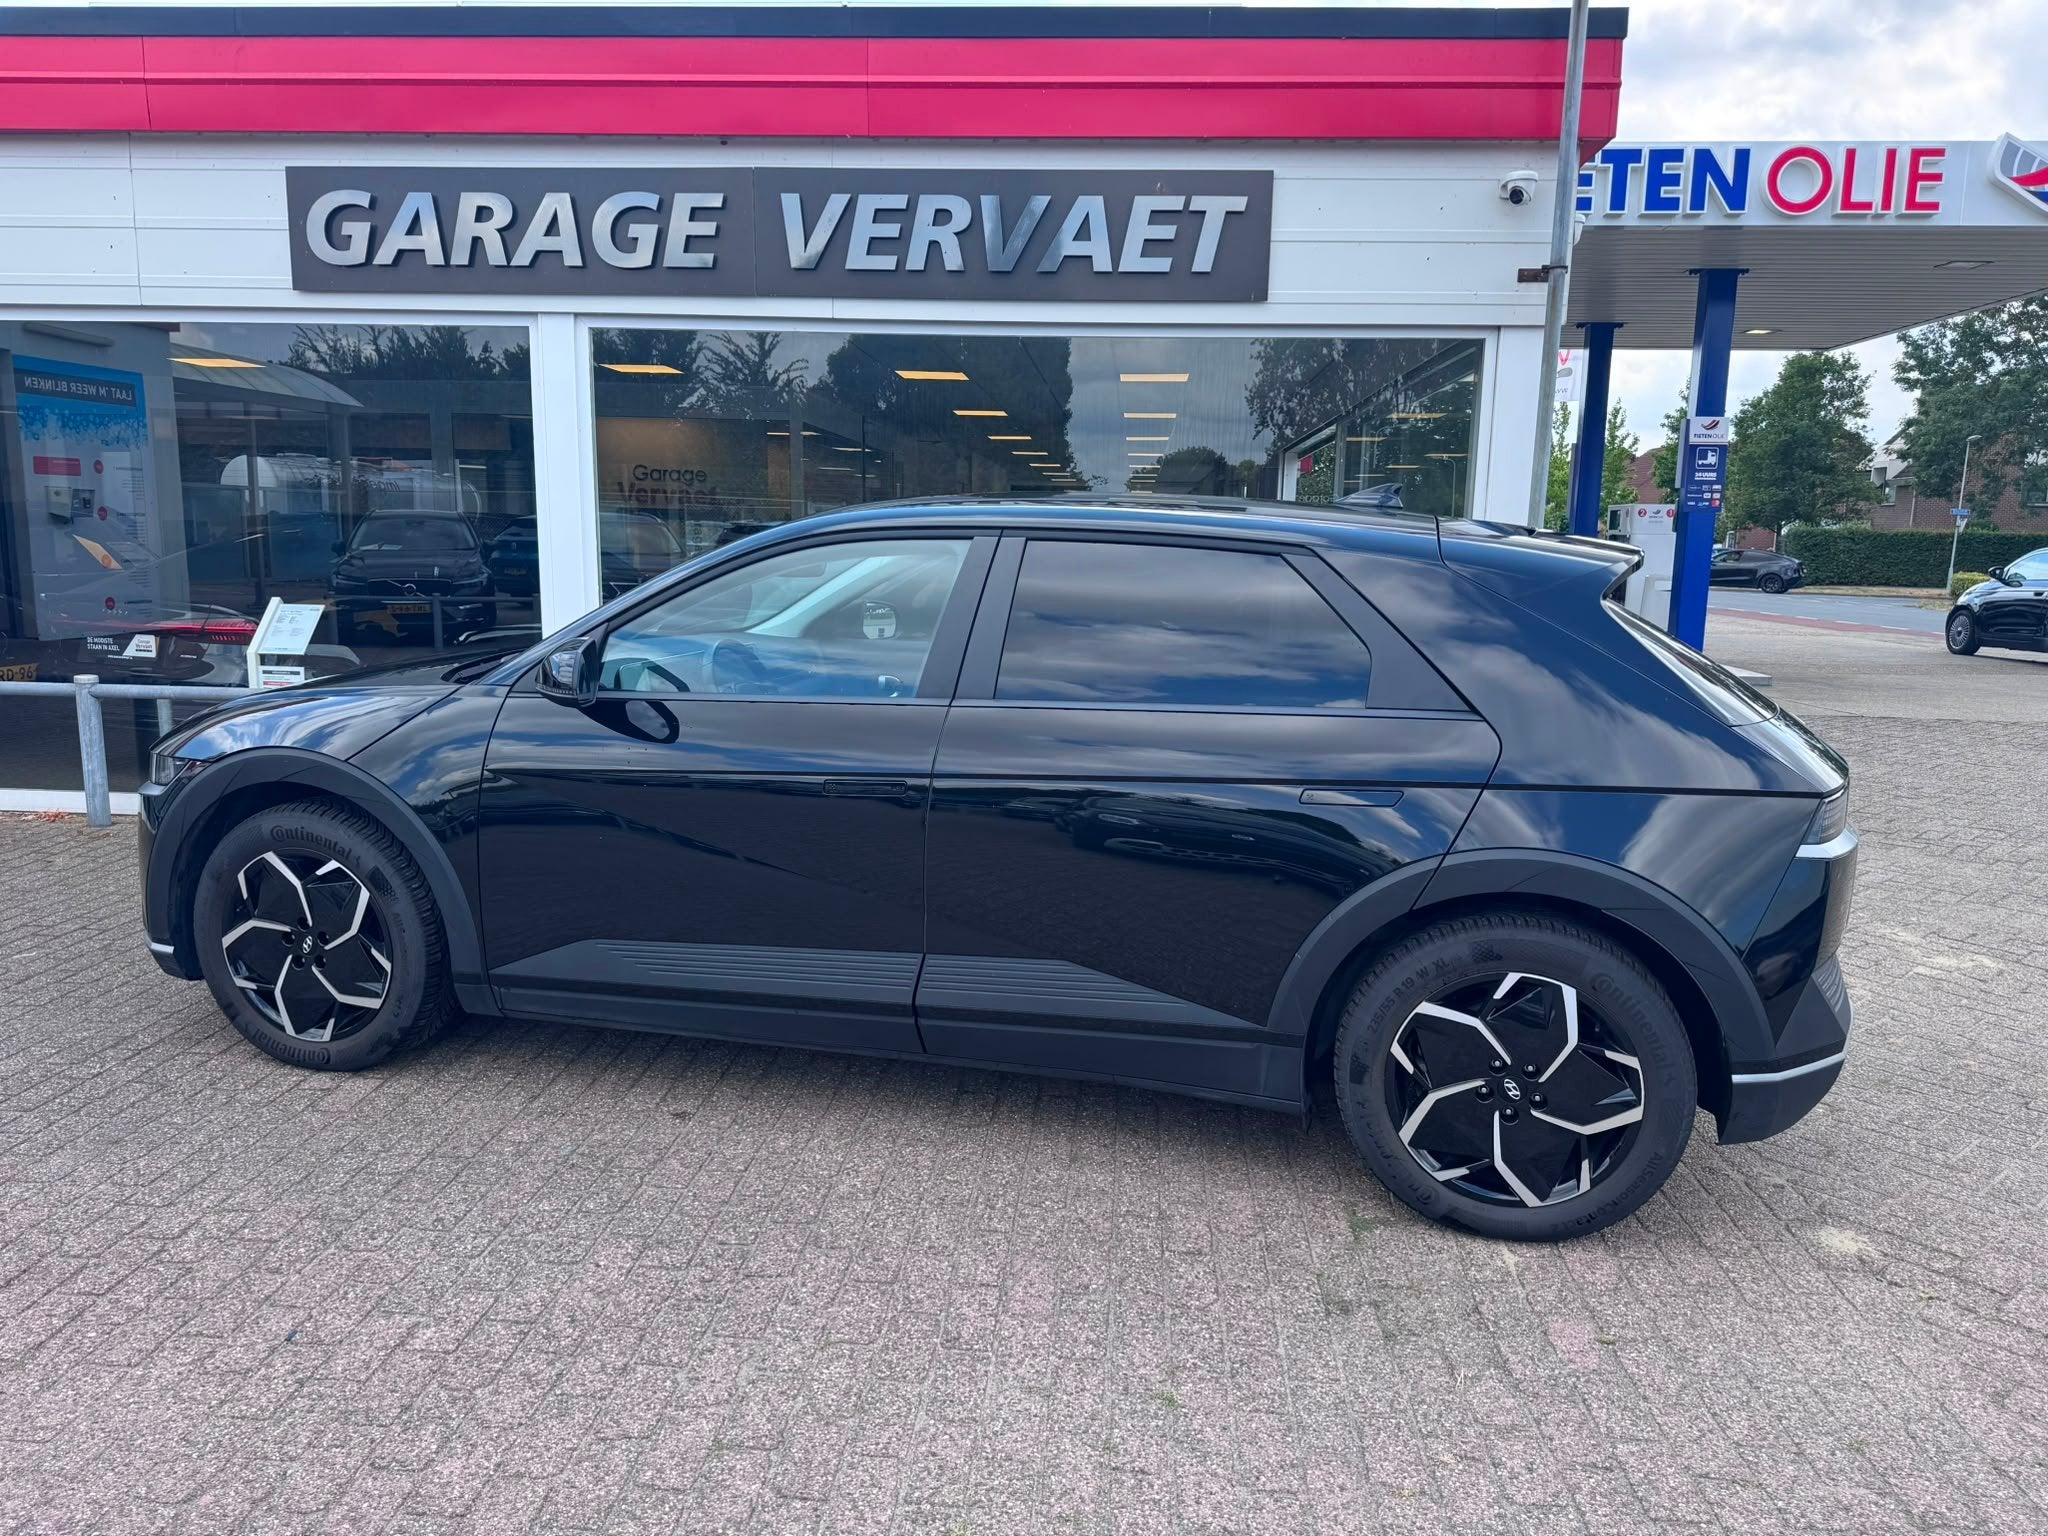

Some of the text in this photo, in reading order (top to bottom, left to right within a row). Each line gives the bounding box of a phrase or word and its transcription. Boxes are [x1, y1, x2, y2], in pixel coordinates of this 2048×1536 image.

[1766, 145, 1947, 215] OLIE
[304, 189, 1248, 274] GARAGE VERVAET
[632, 464, 708, 486] Garage
[270, 825, 353, 860] Continental
[1367, 995, 1395, 1034] 235/55
[1401, 976, 1415, 989] 19
[1416, 966, 1430, 980] W
